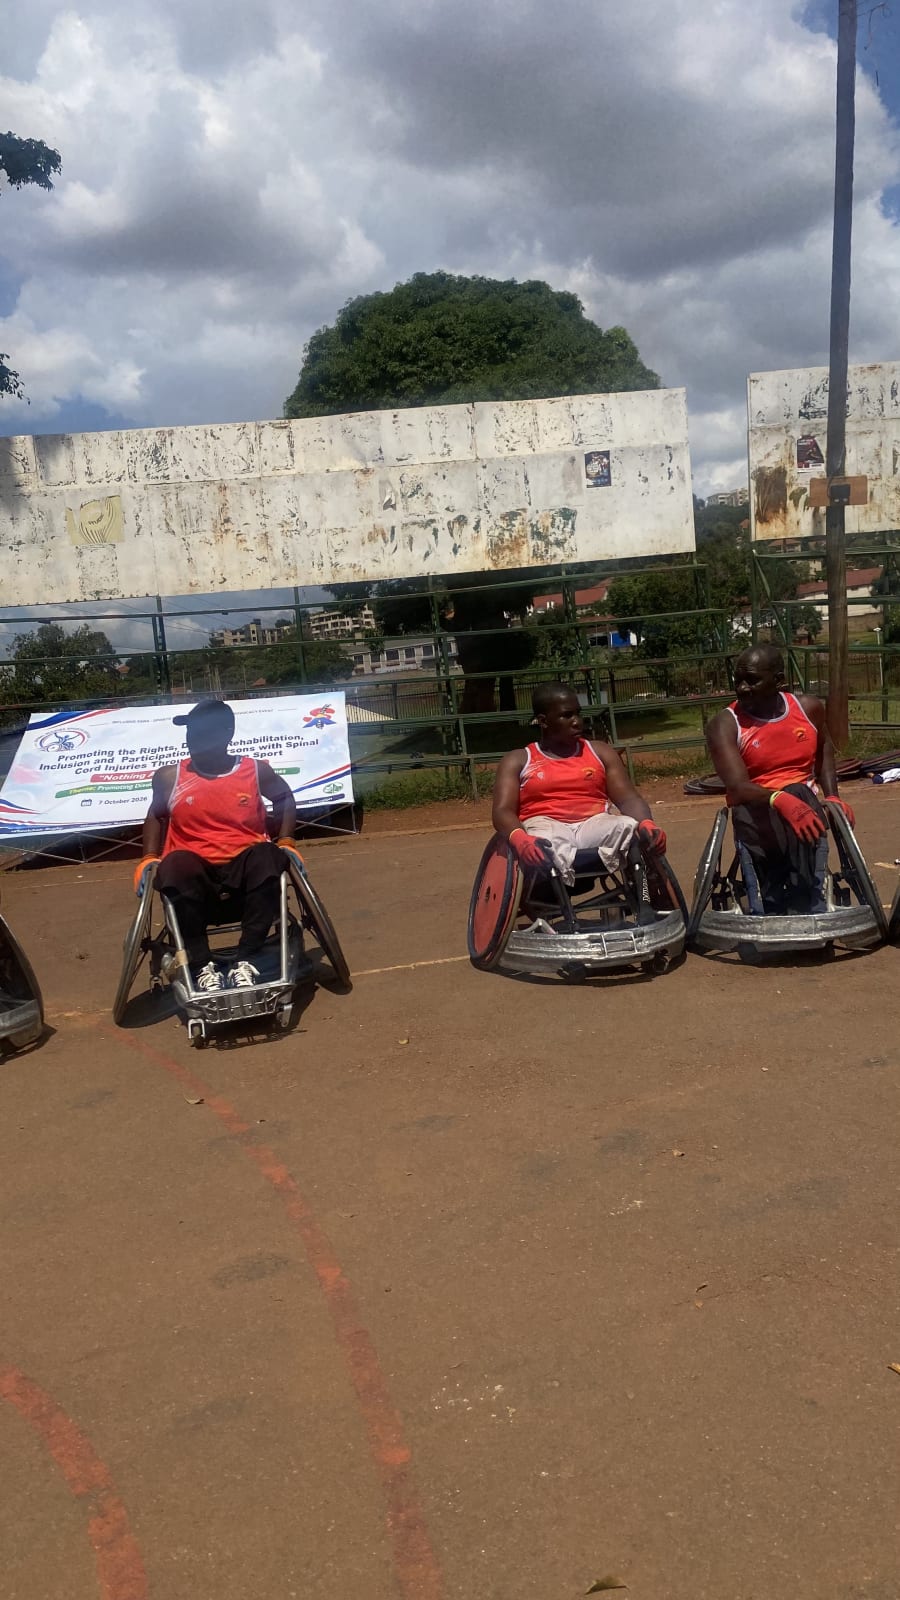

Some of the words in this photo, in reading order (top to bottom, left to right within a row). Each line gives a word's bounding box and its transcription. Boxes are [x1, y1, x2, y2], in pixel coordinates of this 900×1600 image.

[229, 746, 255, 754] sons
[258, 742, 282, 751] with
[286, 738, 319, 749] Spinal
[57, 749, 115, 762] Promoting
[118, 748, 136, 756] the
[139, 744, 178, 755] Rights,
[252, 750, 283, 759] Sport
[39, 760, 91, 771] Inclusion
[75, 765, 101, 774] Cord
[104, 762, 147, 773] Injuries
